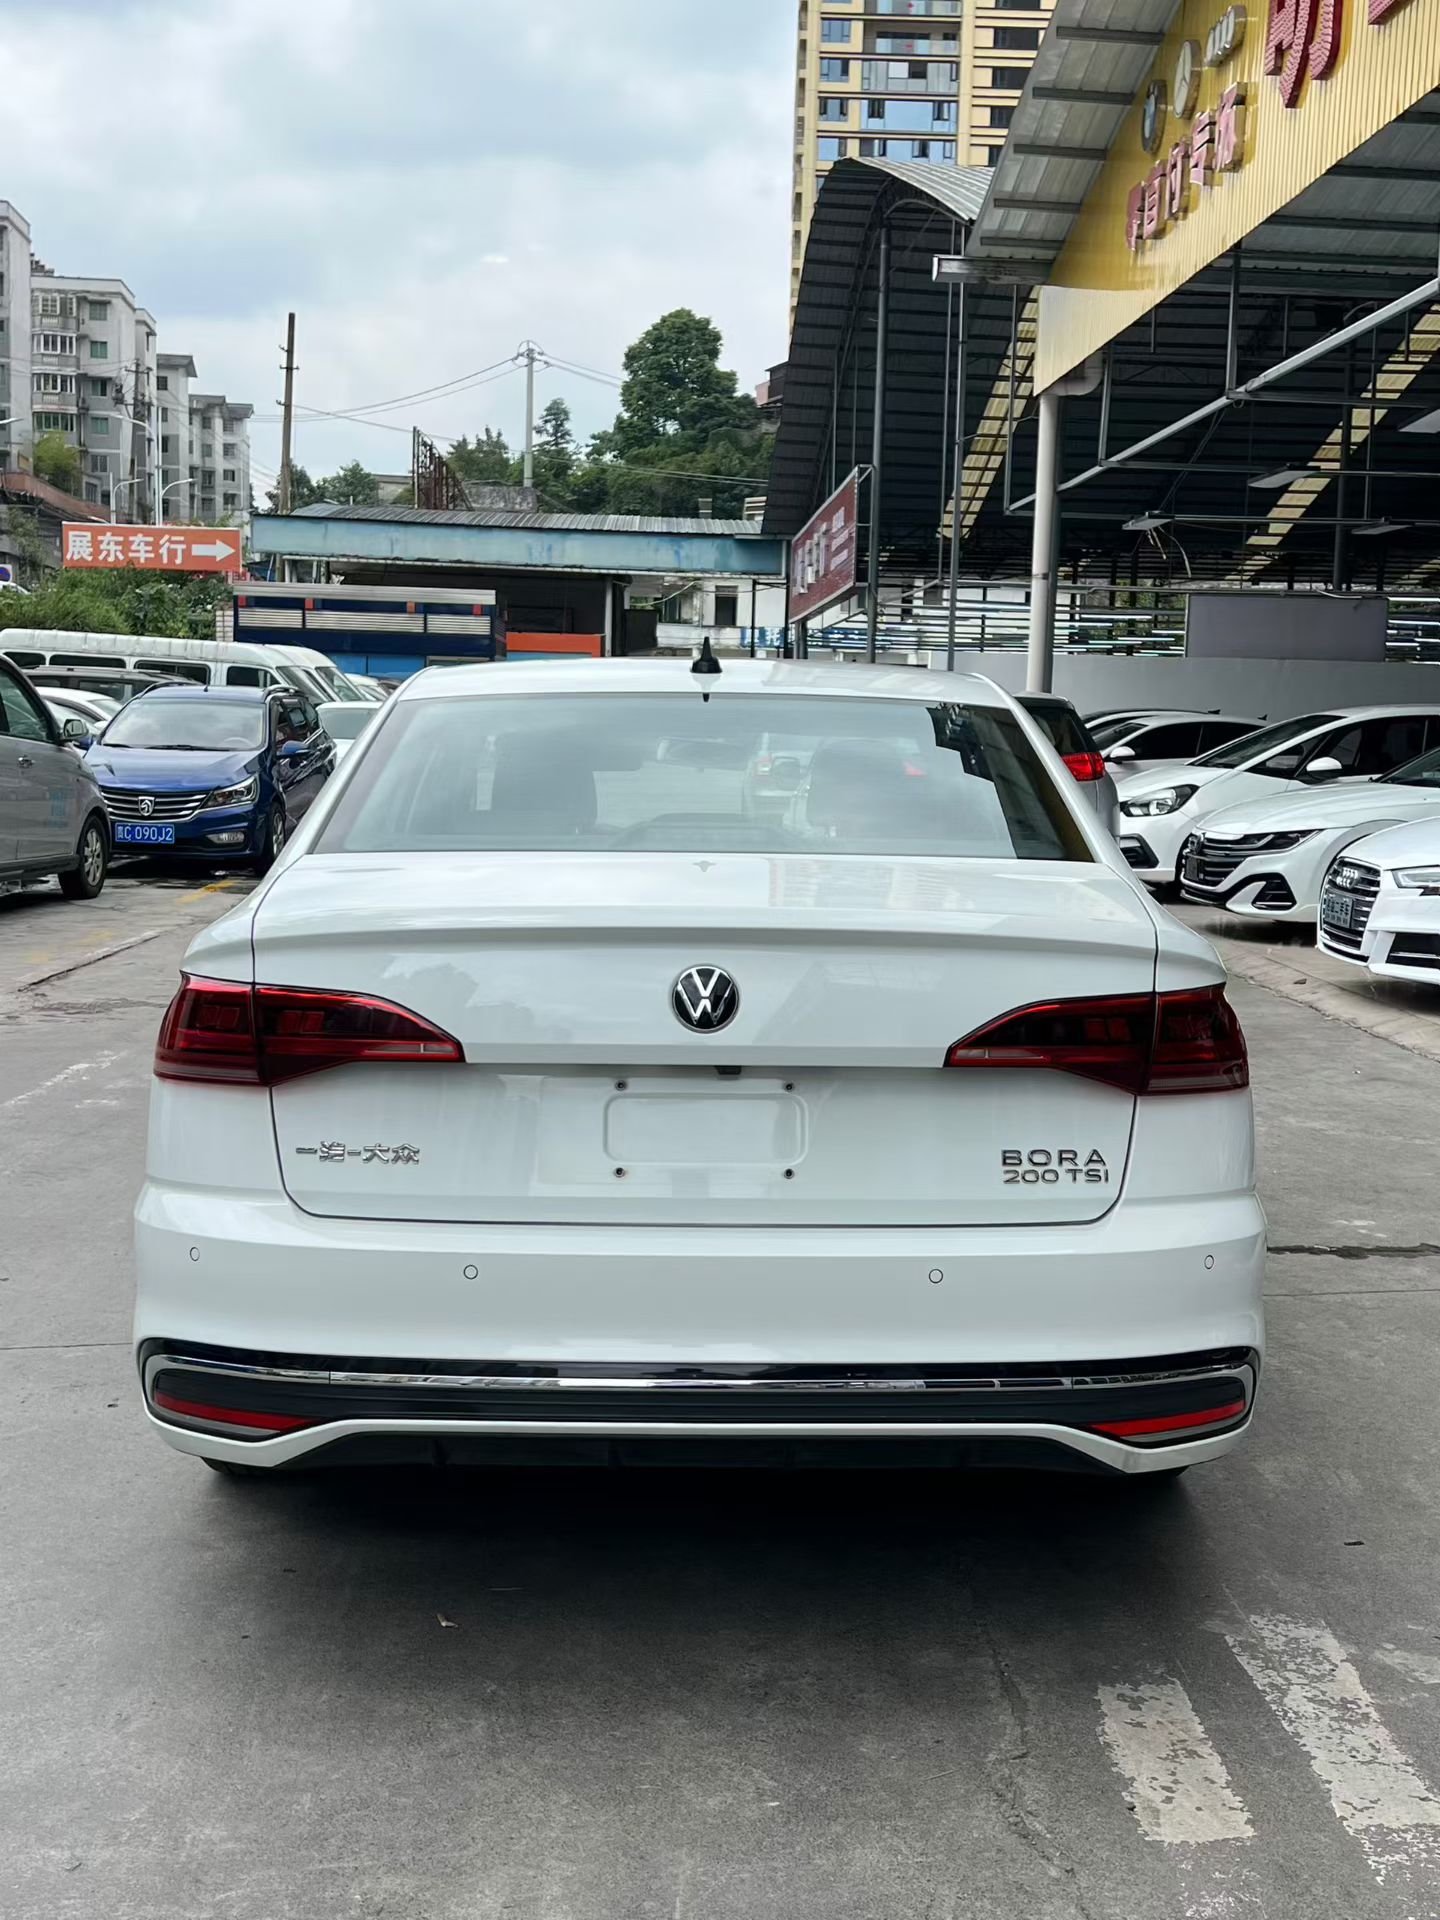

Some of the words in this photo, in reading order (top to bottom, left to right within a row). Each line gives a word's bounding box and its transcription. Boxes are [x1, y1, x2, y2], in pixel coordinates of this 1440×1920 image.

[66, 530, 187, 565] 展东车行
[1001, 1149, 1107, 1167] BORA
[1003, 1168, 1059, 1184] 200
